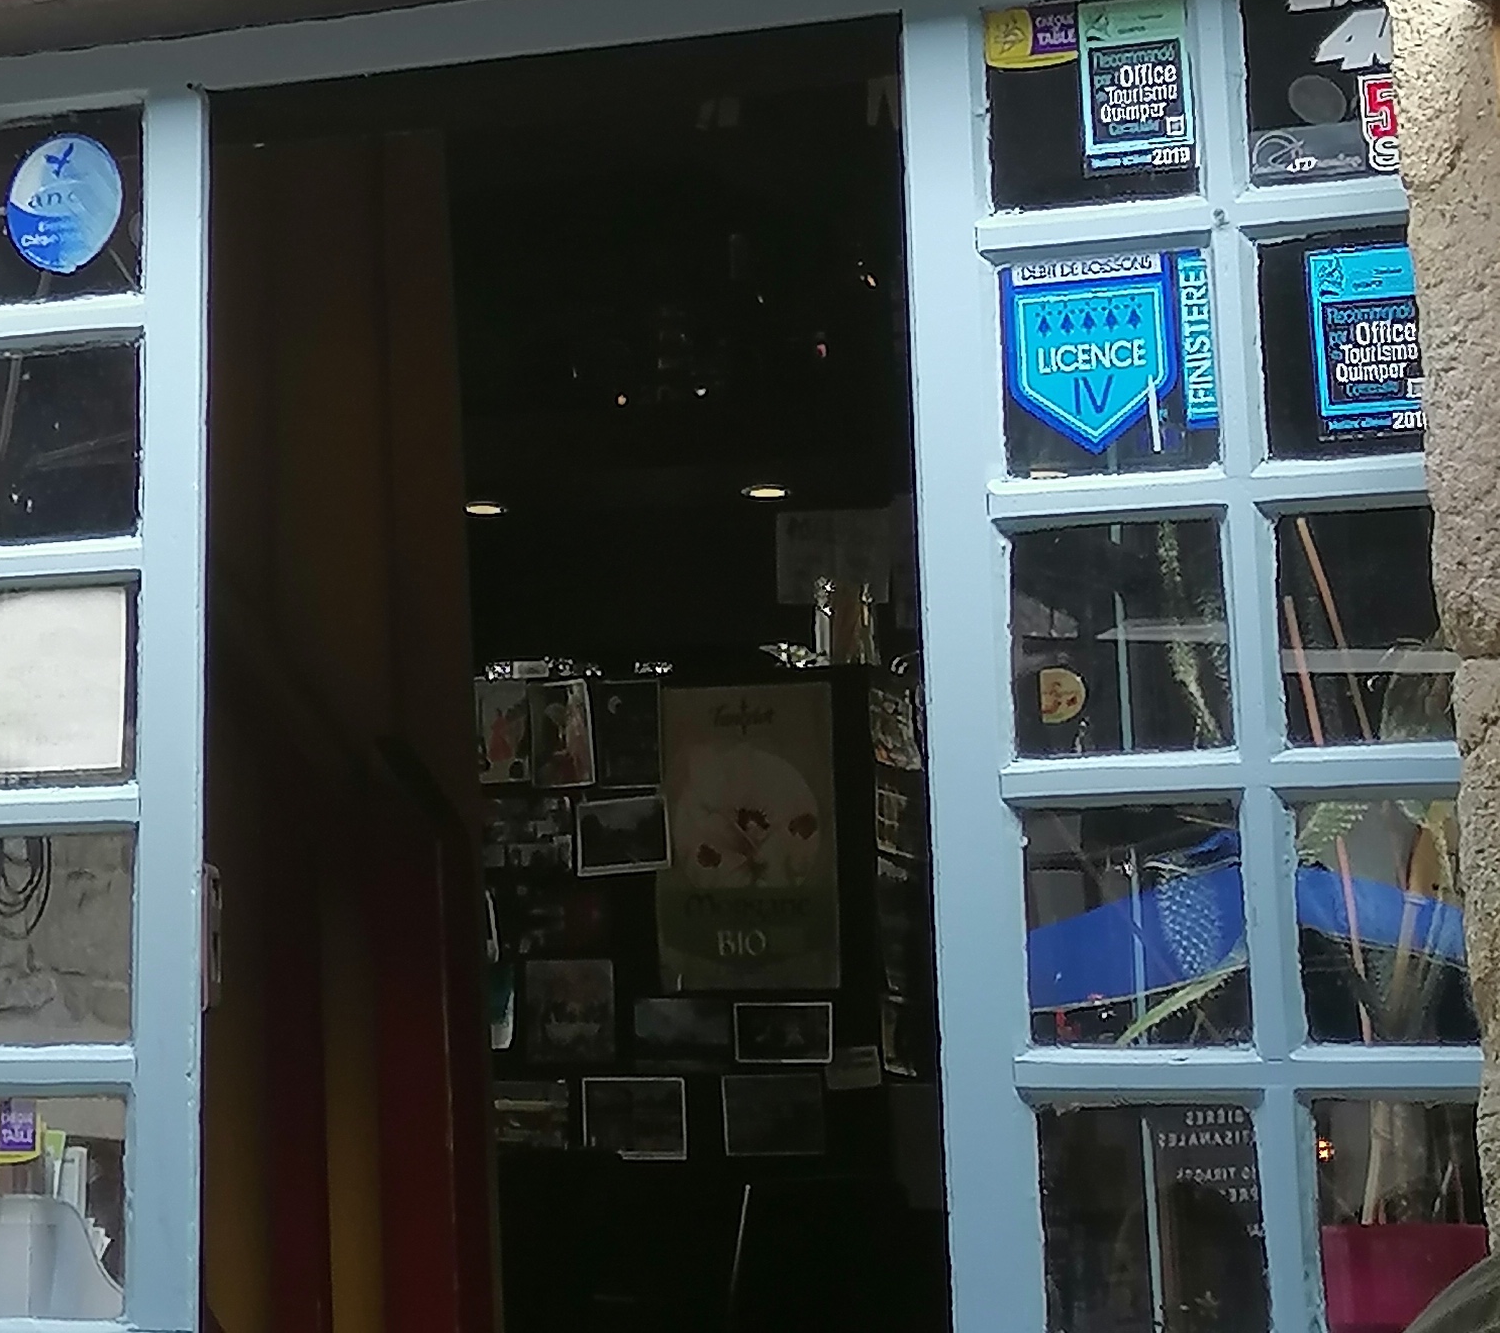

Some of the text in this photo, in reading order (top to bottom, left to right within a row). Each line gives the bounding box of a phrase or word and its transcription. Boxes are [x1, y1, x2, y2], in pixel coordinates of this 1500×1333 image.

[1104, 84, 1178, 106] Tourisme
[1100, 102, 1167, 124] Quimper
[1036, 337, 1149, 375] LICENCE
[1340, 343, 1419, 366] Tourisme
[1335, 362, 1408, 384] Quimper
[1072, 375, 1117, 416] IV
[1391, 410, 1427, 431] 201
[716, 929, 767, 957] BIO
